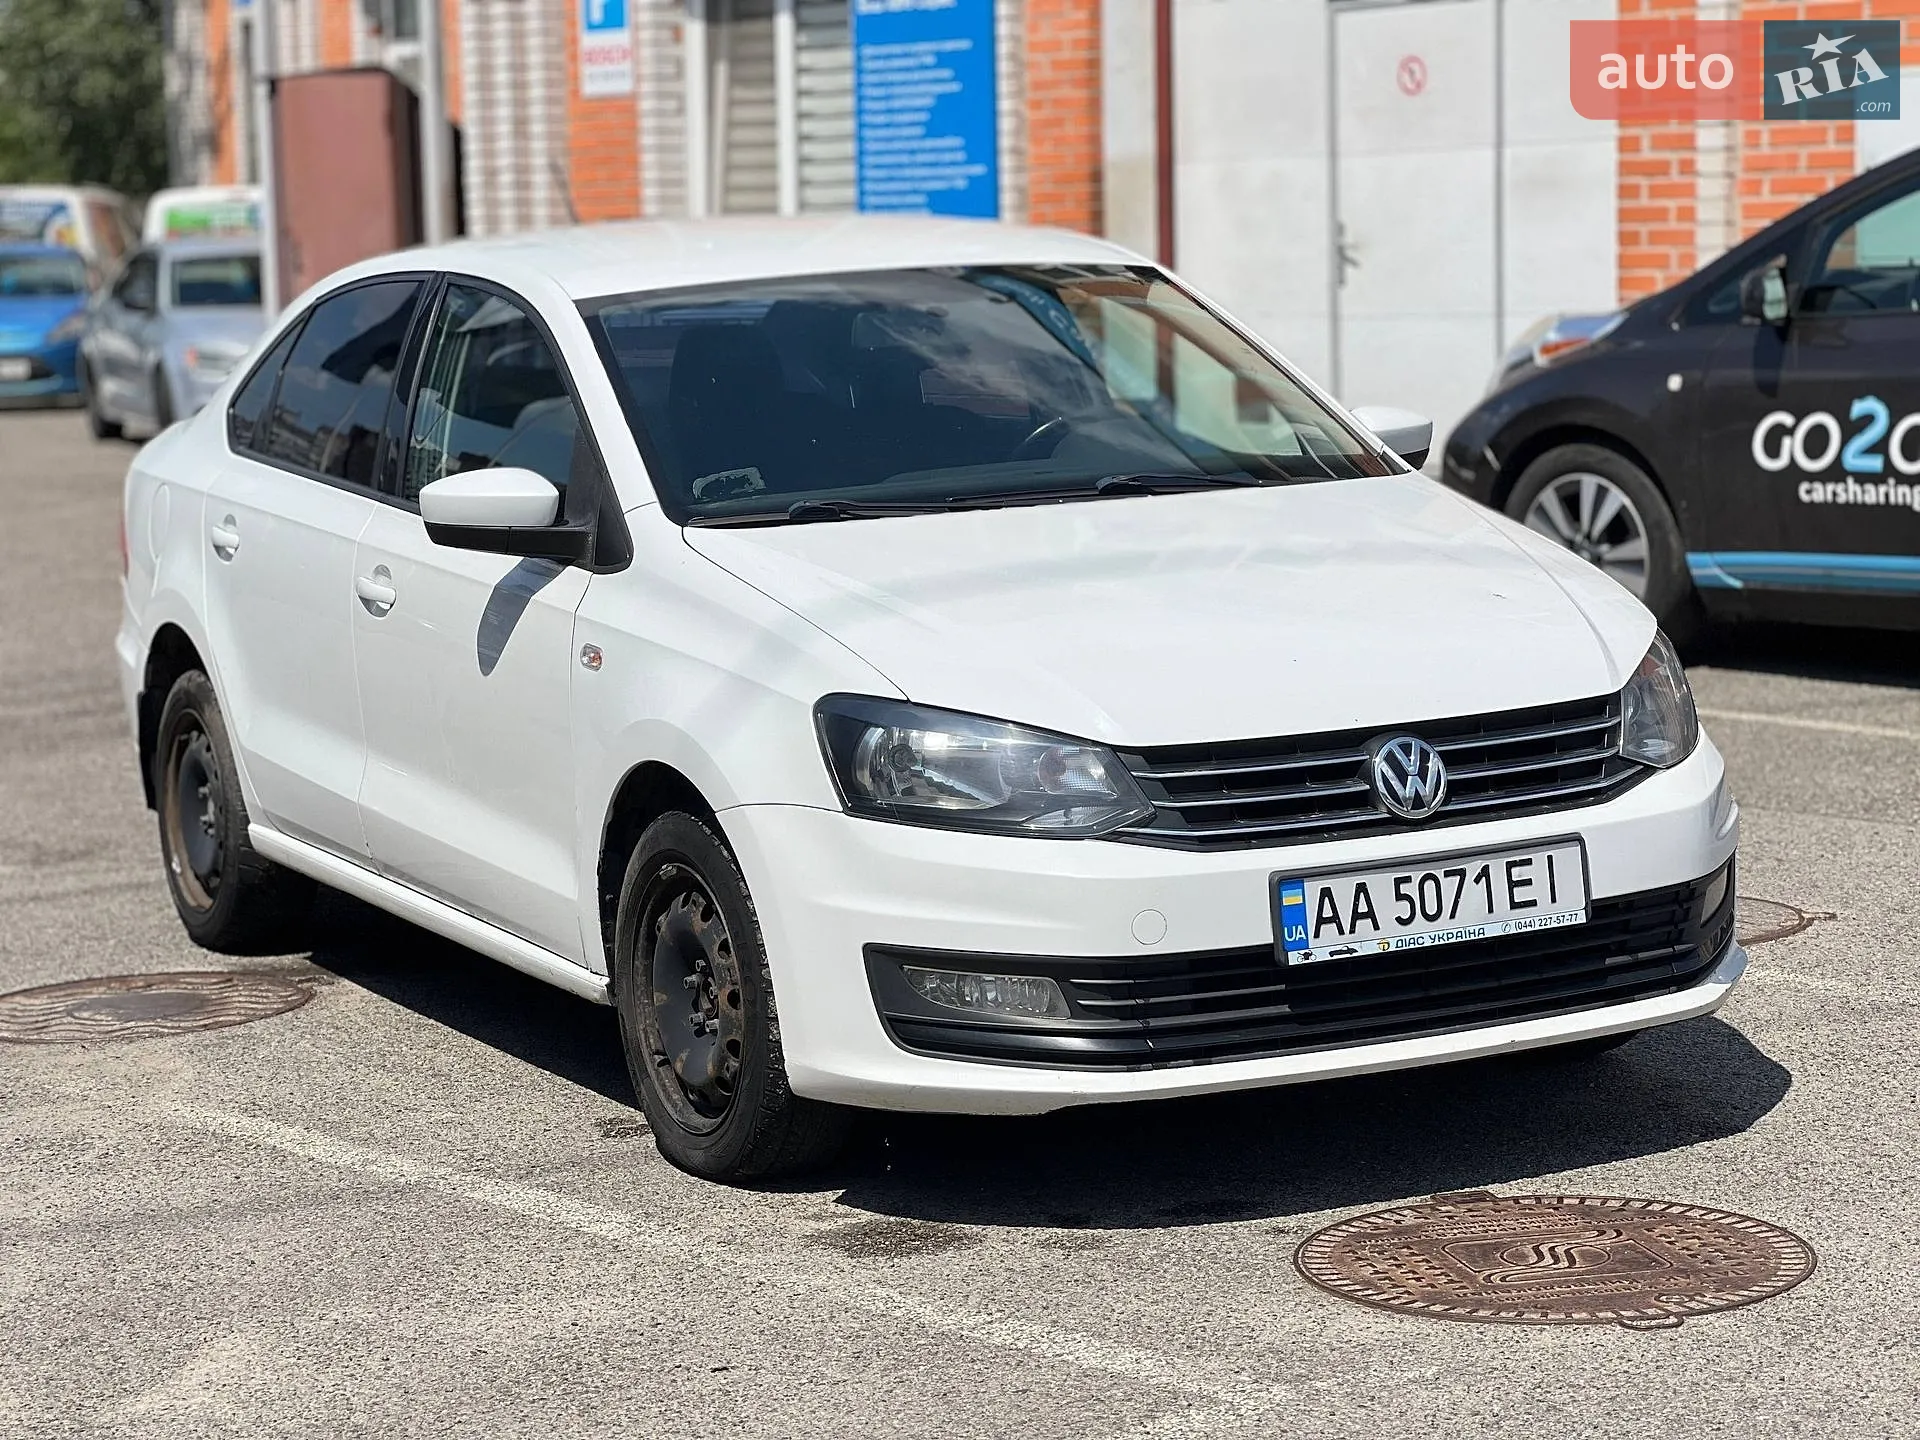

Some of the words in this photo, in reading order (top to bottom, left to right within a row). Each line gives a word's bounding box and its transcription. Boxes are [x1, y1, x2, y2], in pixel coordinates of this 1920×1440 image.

[1313, 881, 1380, 939] AA
[1393, 864, 1495, 926] 5071
[1514, 918, 1536, 932] (044)
[1538, 913, 1579, 928] 227-57-77
[1283, 925, 1306, 942] UA
[1394, 936, 1426, 950] ДІАС
[1429, 927, 1486, 944] УКРАЇНА
